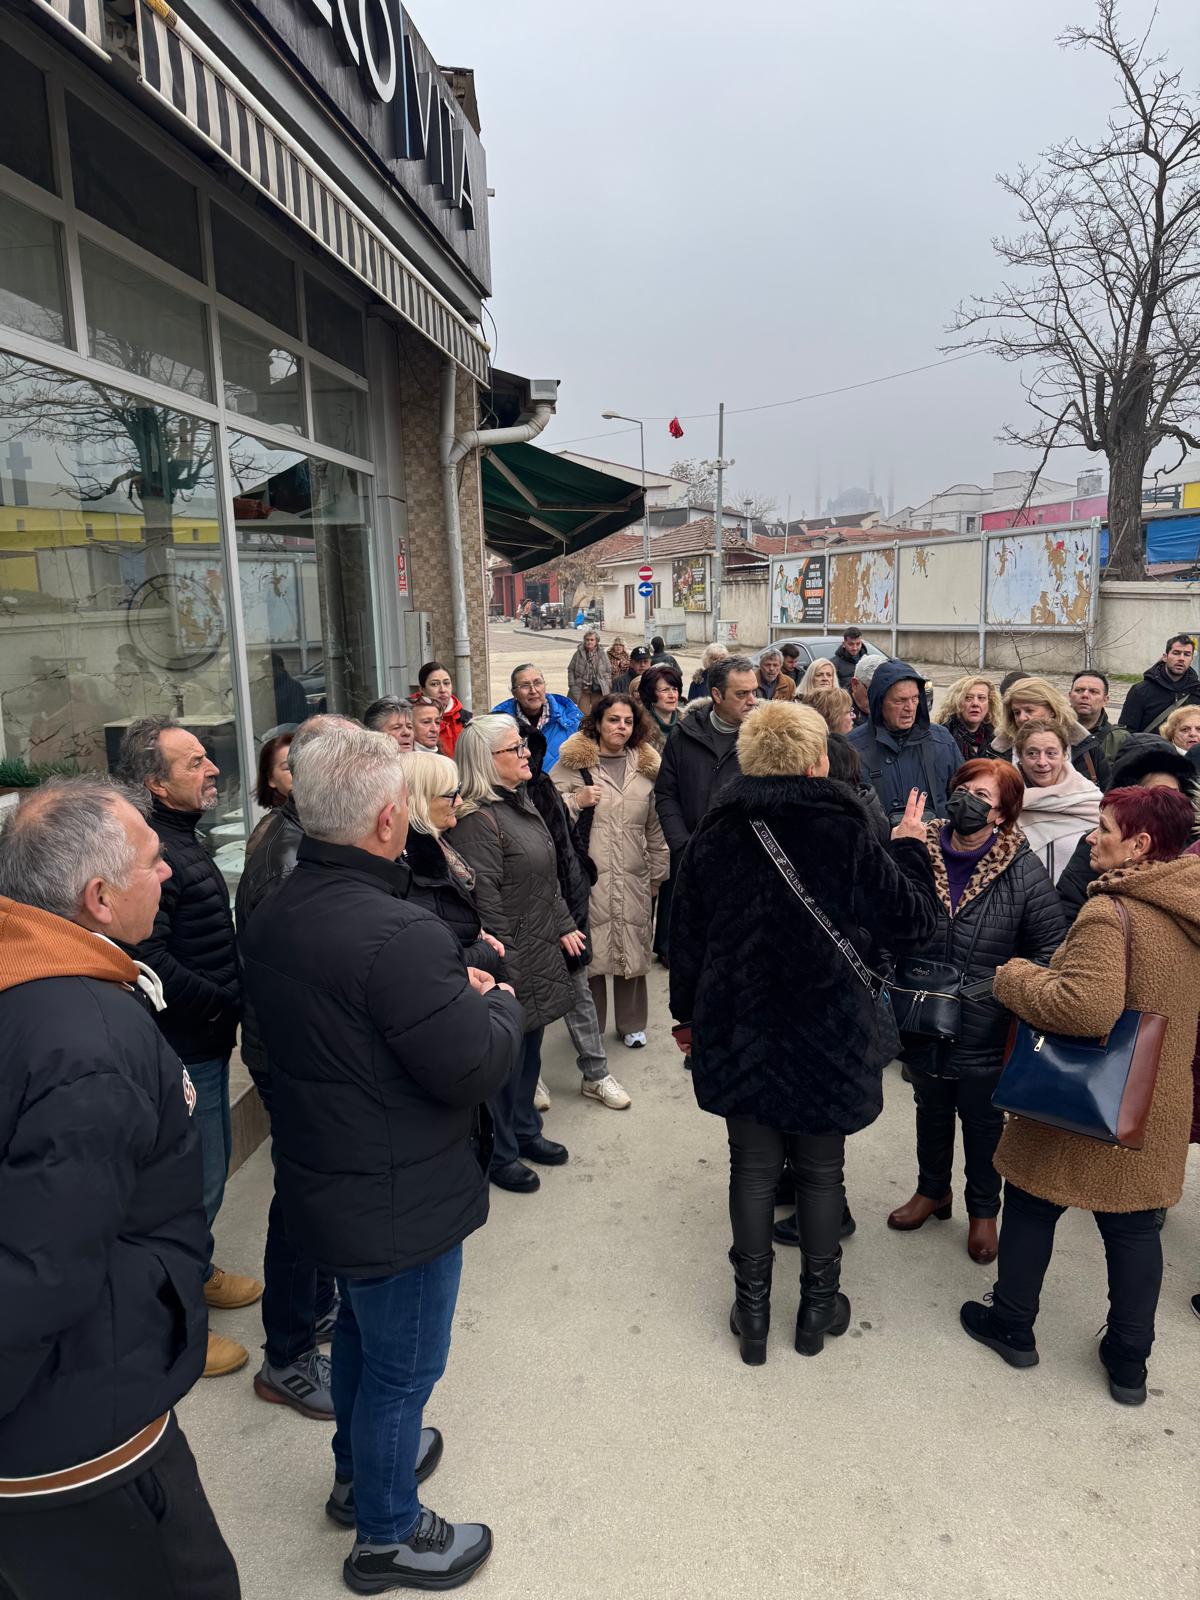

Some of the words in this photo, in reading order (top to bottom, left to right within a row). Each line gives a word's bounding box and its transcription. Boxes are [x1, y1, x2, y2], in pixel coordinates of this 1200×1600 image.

[760, 830, 778, 854] GUESS
[786, 868, 805, 894] GUESS
[814, 906, 833, 928] GUESS
